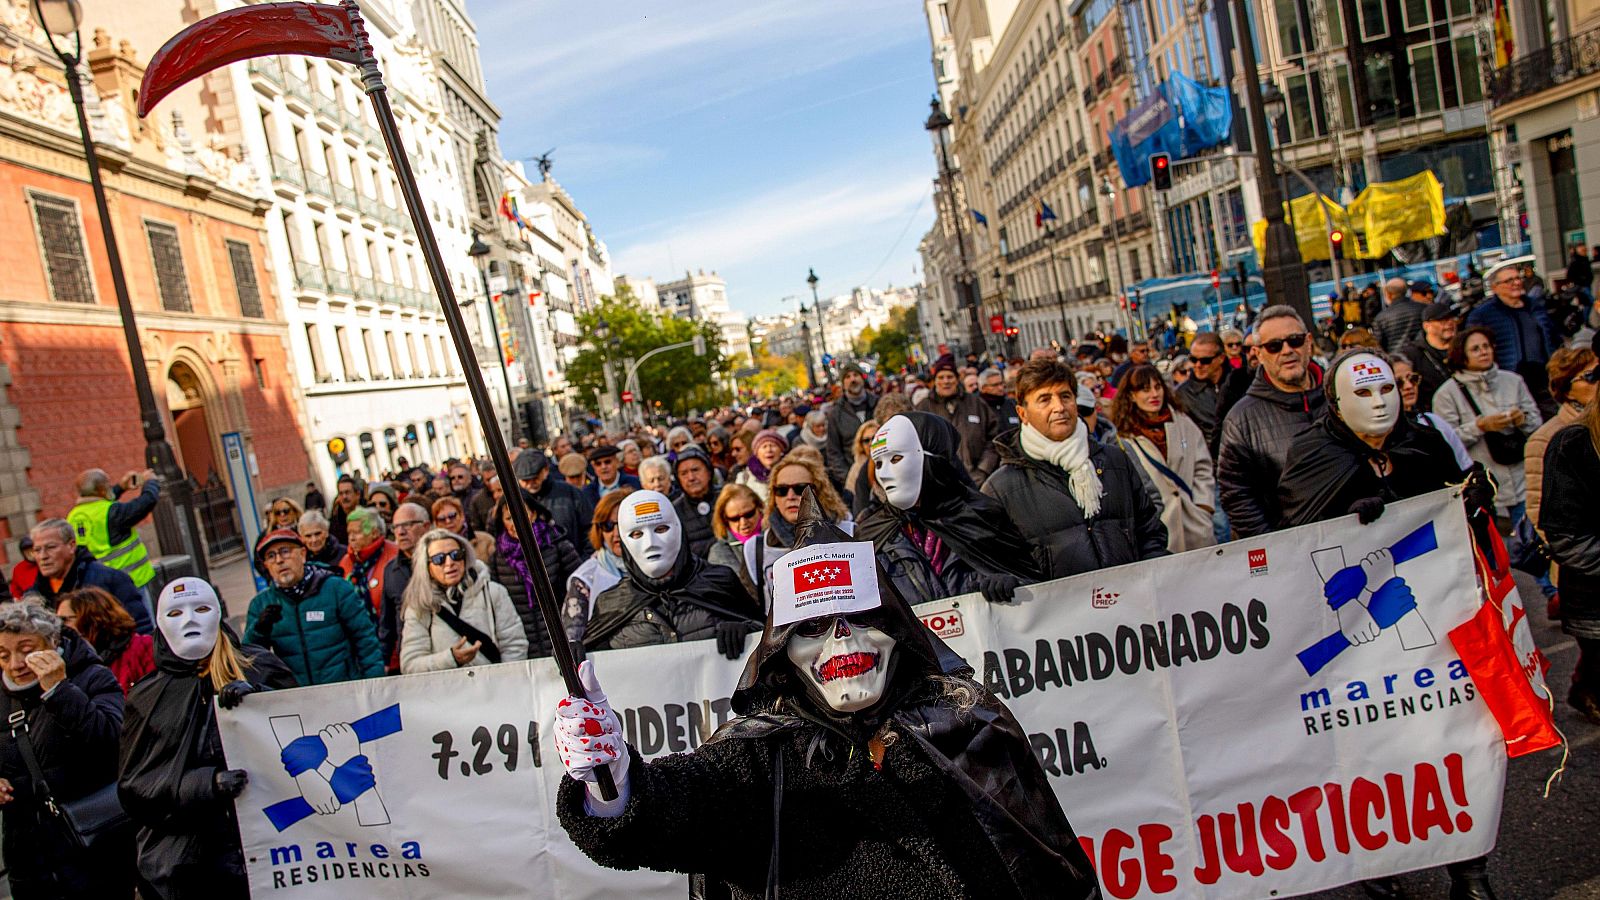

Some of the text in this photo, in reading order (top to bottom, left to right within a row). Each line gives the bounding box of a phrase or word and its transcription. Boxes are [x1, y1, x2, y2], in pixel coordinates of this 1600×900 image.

[787, 554, 822, 567] Residencias
[432, 721, 542, 780] 7.291
[983, 599, 1270, 700] ABANDONADOS
[1300, 659, 1469, 711] marea
[1303, 683, 1475, 735] RESIDENCIAS
[1194, 753, 1473, 884] JUSTICIA!
[270, 841, 422, 866] marea
[273, 862, 430, 889] RESIDENCIAS
